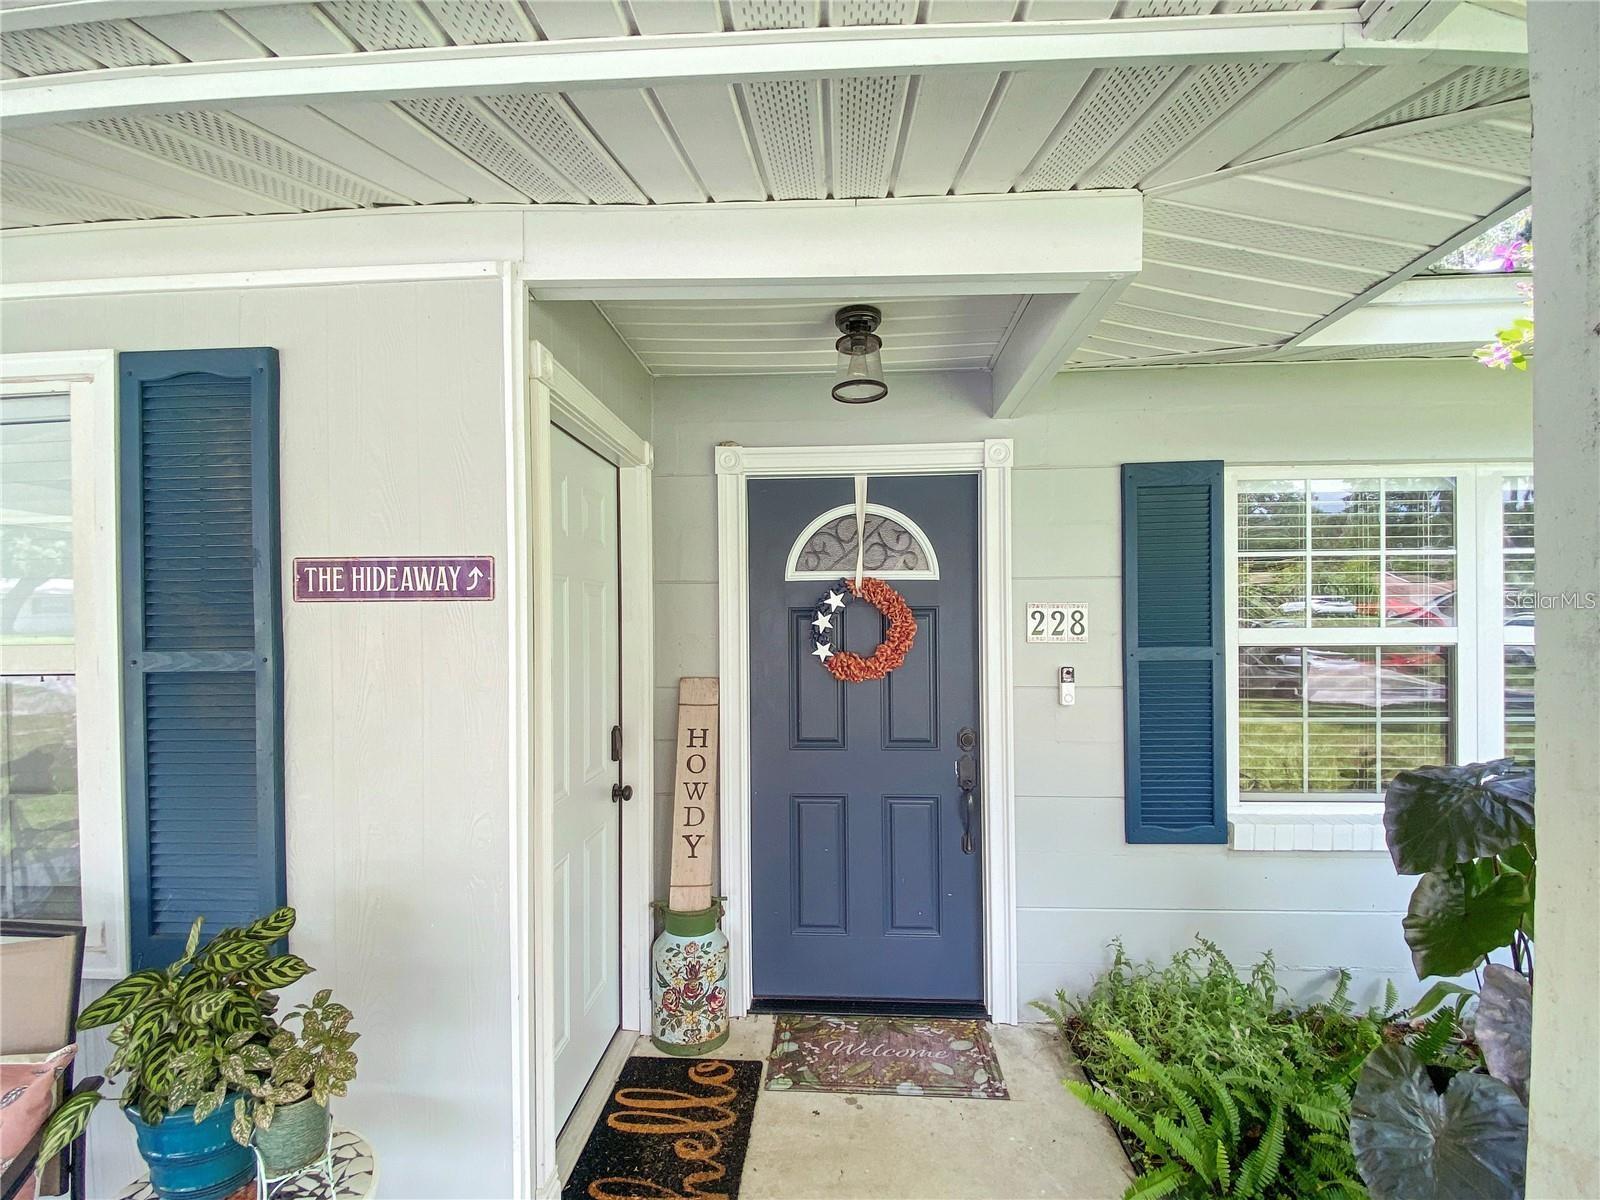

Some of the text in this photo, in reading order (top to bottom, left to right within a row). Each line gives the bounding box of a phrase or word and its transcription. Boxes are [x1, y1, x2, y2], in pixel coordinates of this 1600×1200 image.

[304, 566, 461, 592] THE HIDEAWAY
[1030, 610, 1085, 636] 228
[682, 728, 709, 858] HOWDY
[824, 1039, 949, 1060] Welcome
